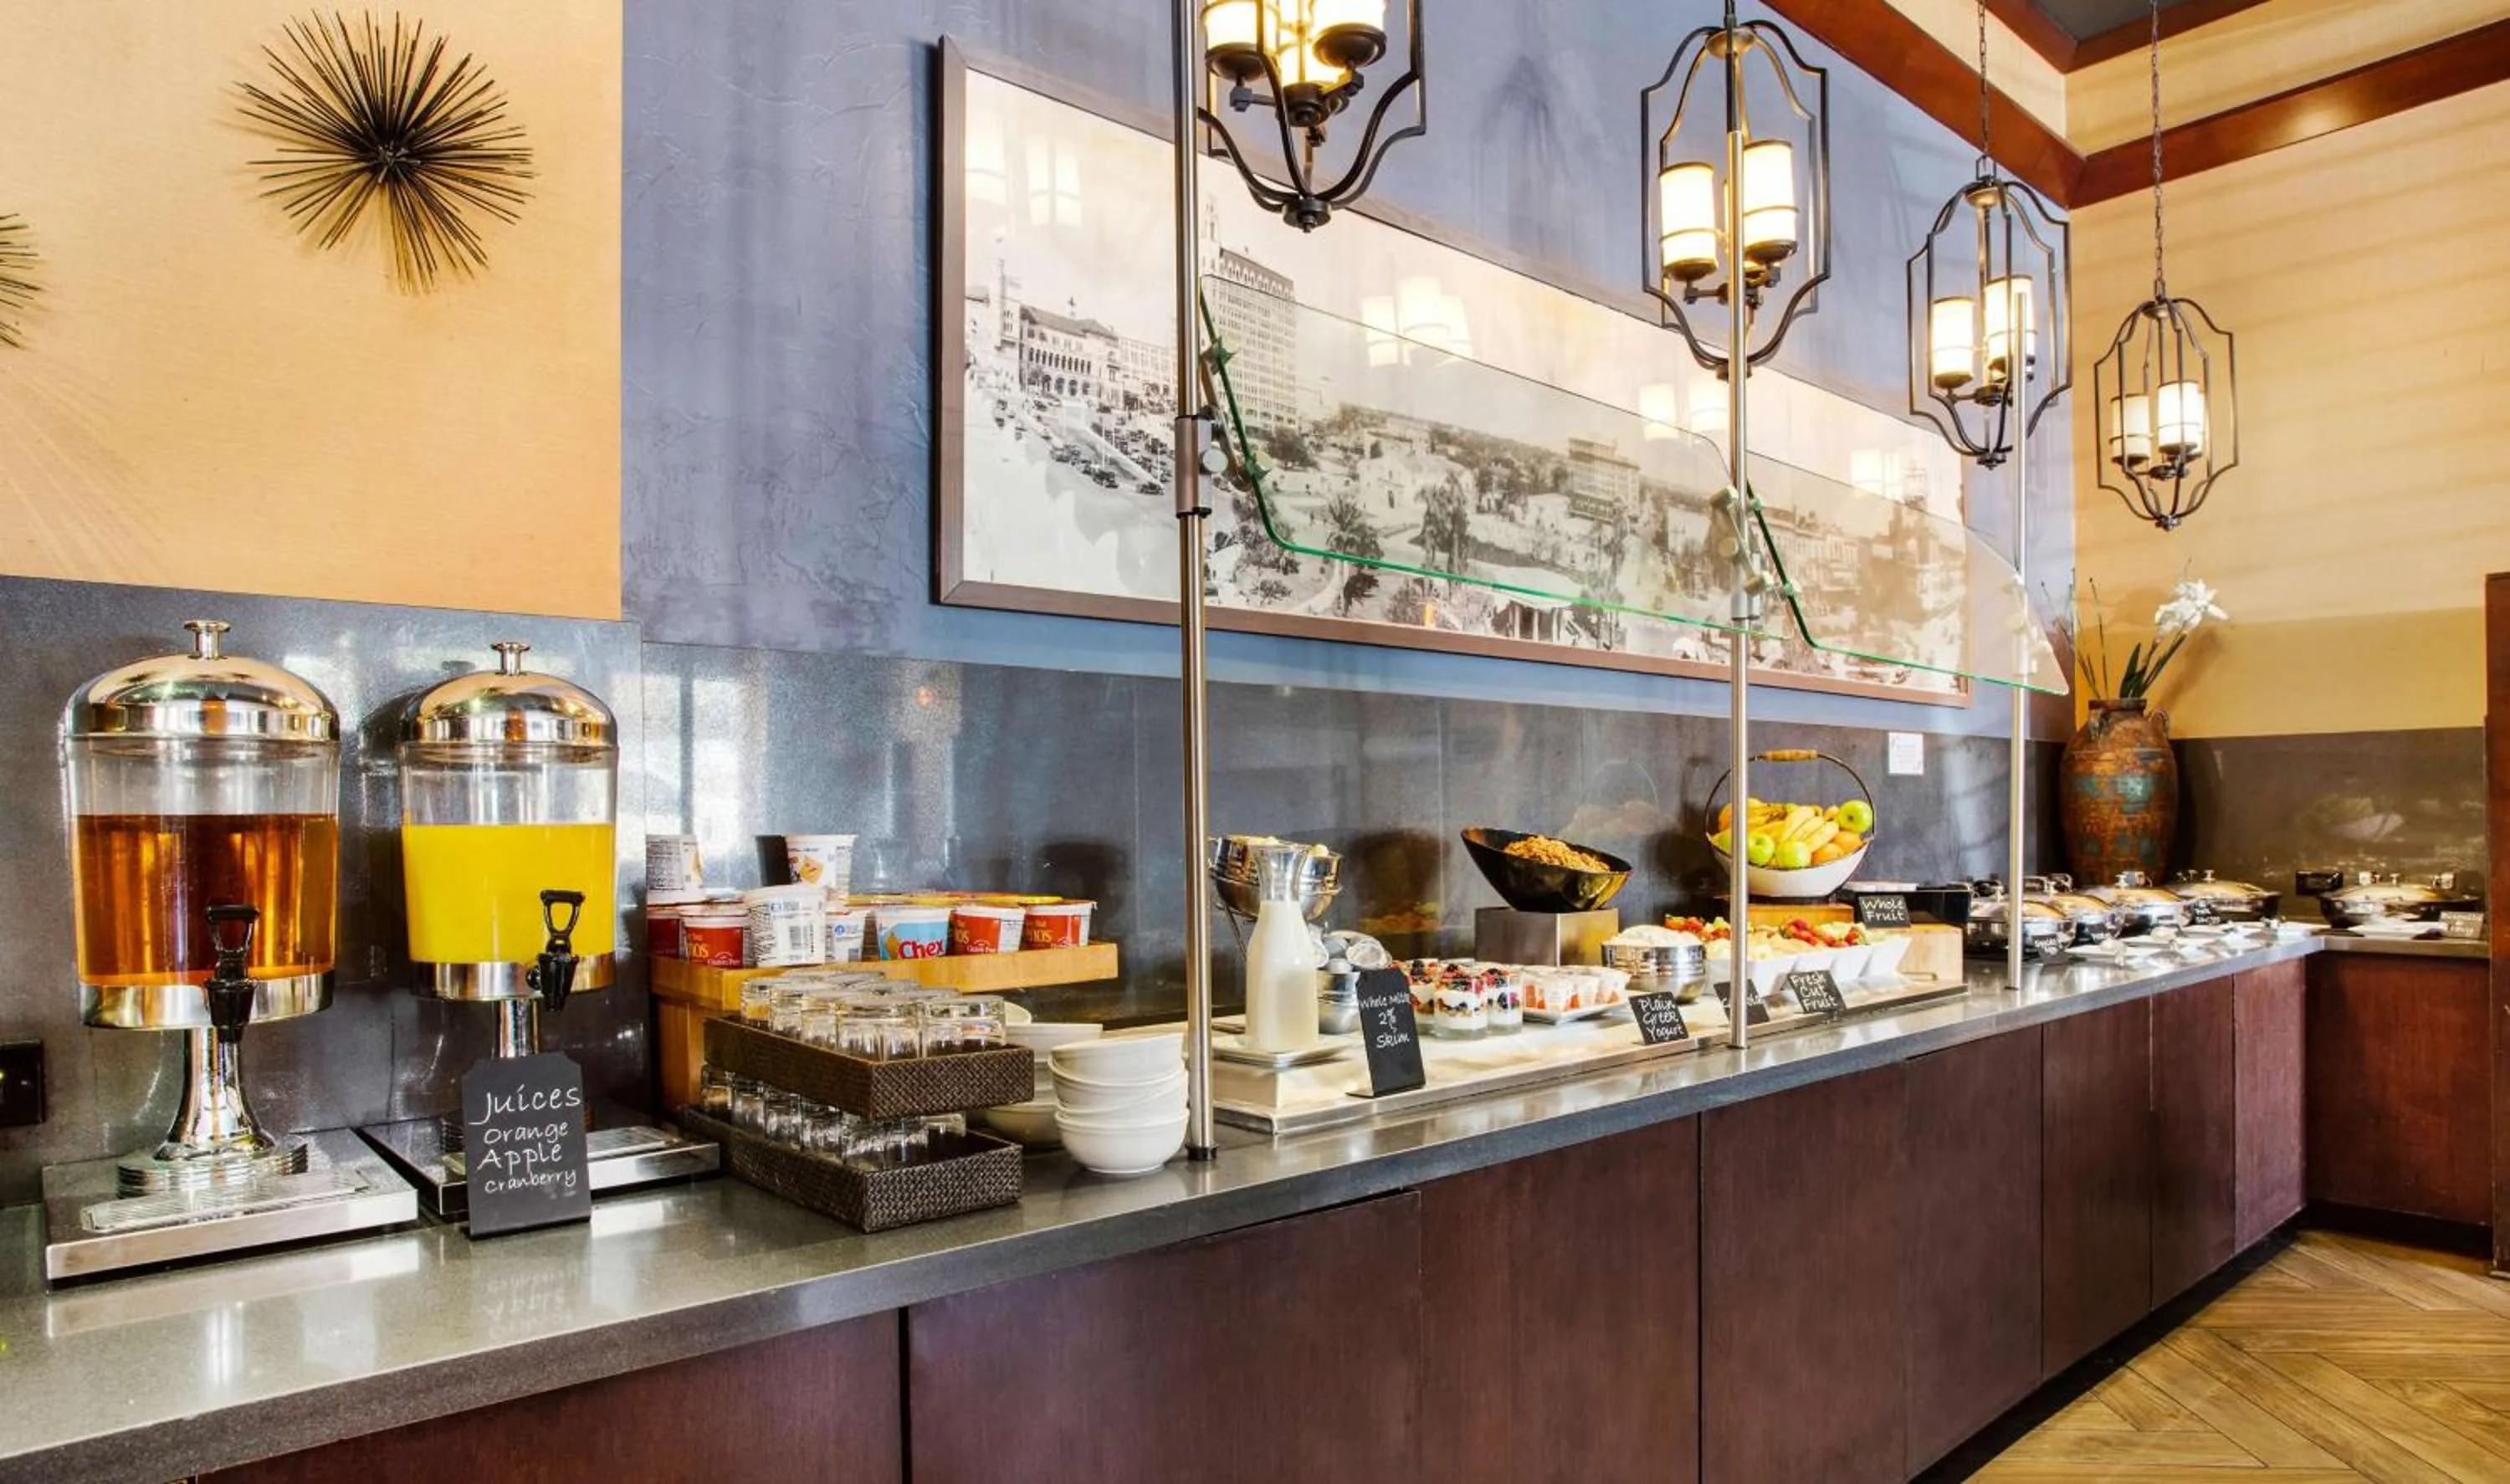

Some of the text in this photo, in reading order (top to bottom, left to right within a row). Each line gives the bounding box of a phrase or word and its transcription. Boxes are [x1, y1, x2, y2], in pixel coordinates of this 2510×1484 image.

[1867, 910, 1905, 921] Fruit
[898, 939, 945, 959] Chex
[1638, 995, 1676, 1012] Plain
[469, 1084, 582, 1125] Juices
[477, 1143, 562, 1175] Apple
[484, 1169, 576, 1194] cranberry
